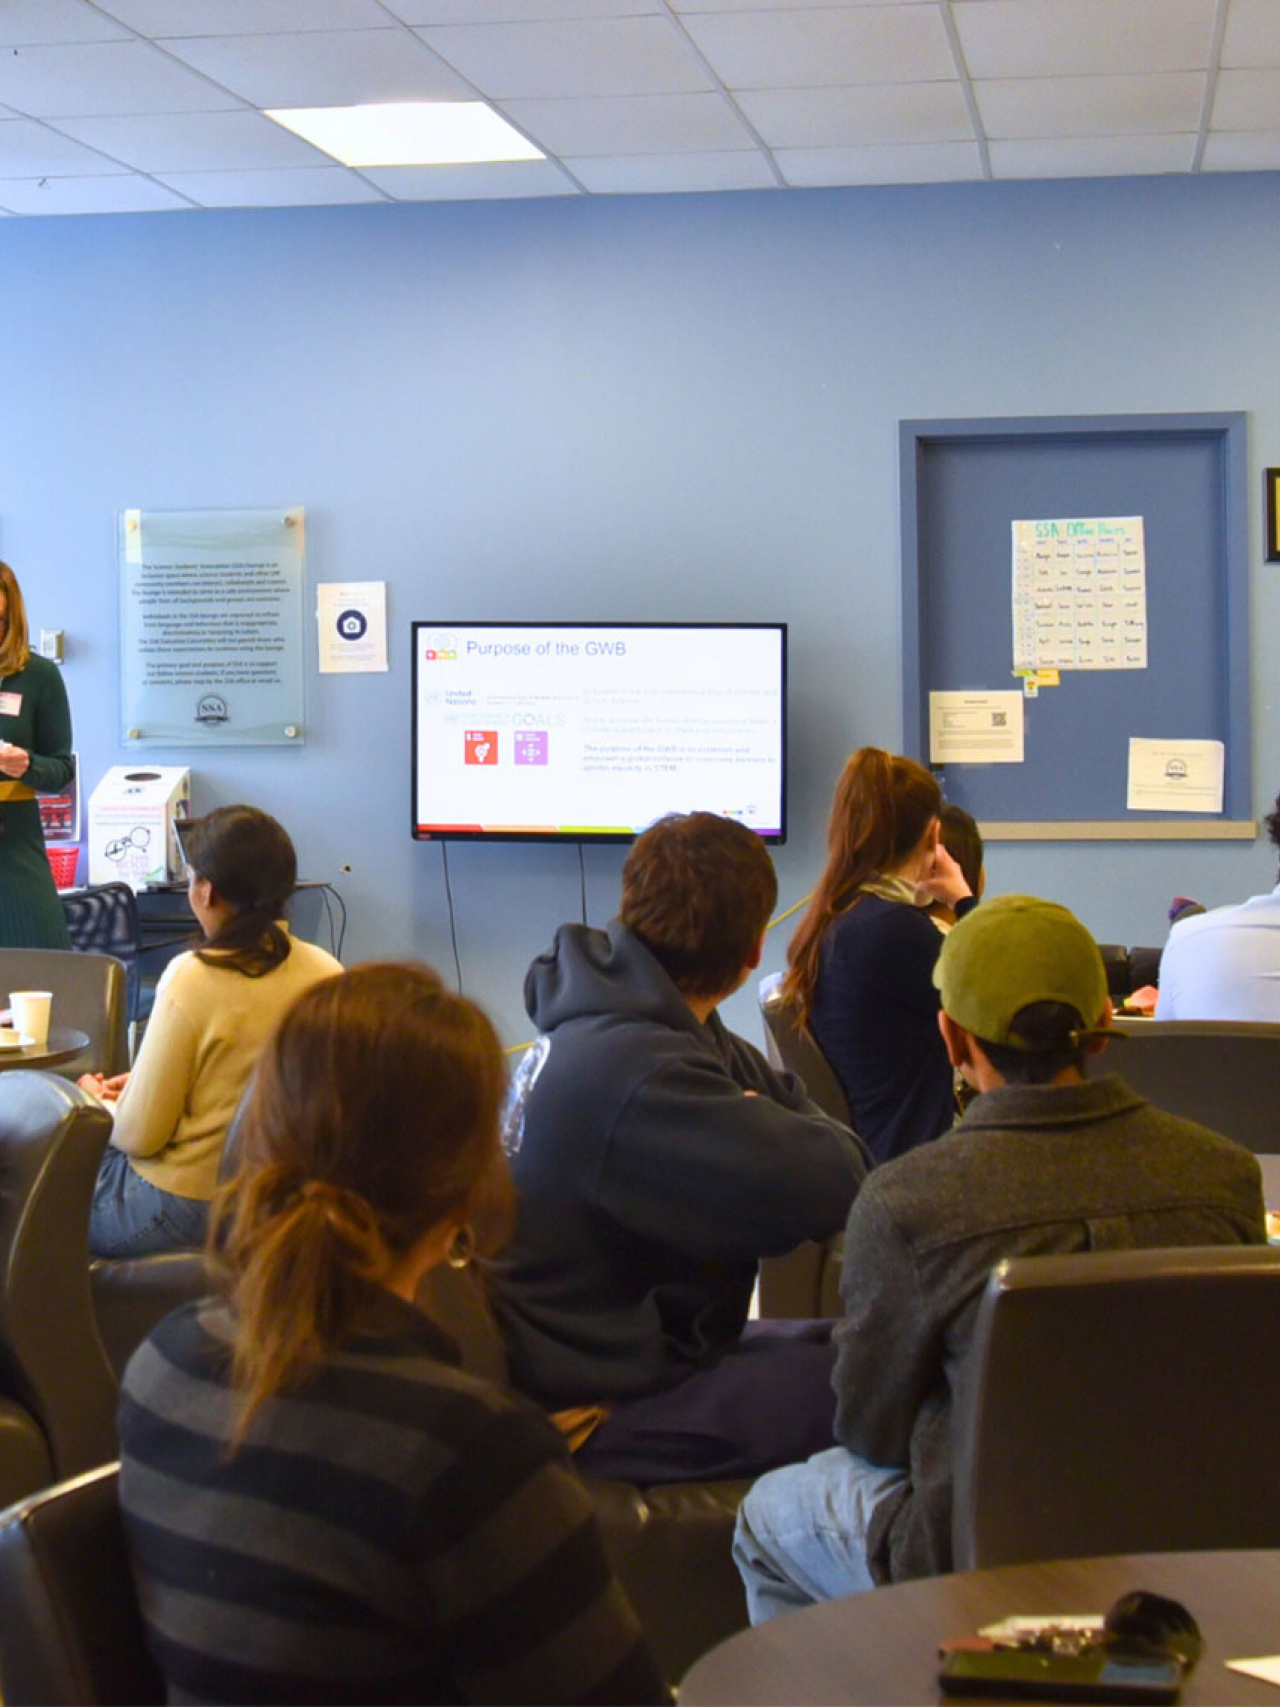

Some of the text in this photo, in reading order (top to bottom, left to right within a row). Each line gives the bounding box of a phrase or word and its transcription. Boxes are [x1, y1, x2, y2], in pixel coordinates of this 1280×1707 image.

[466, 641, 627, 657] Purpose of the GWB
